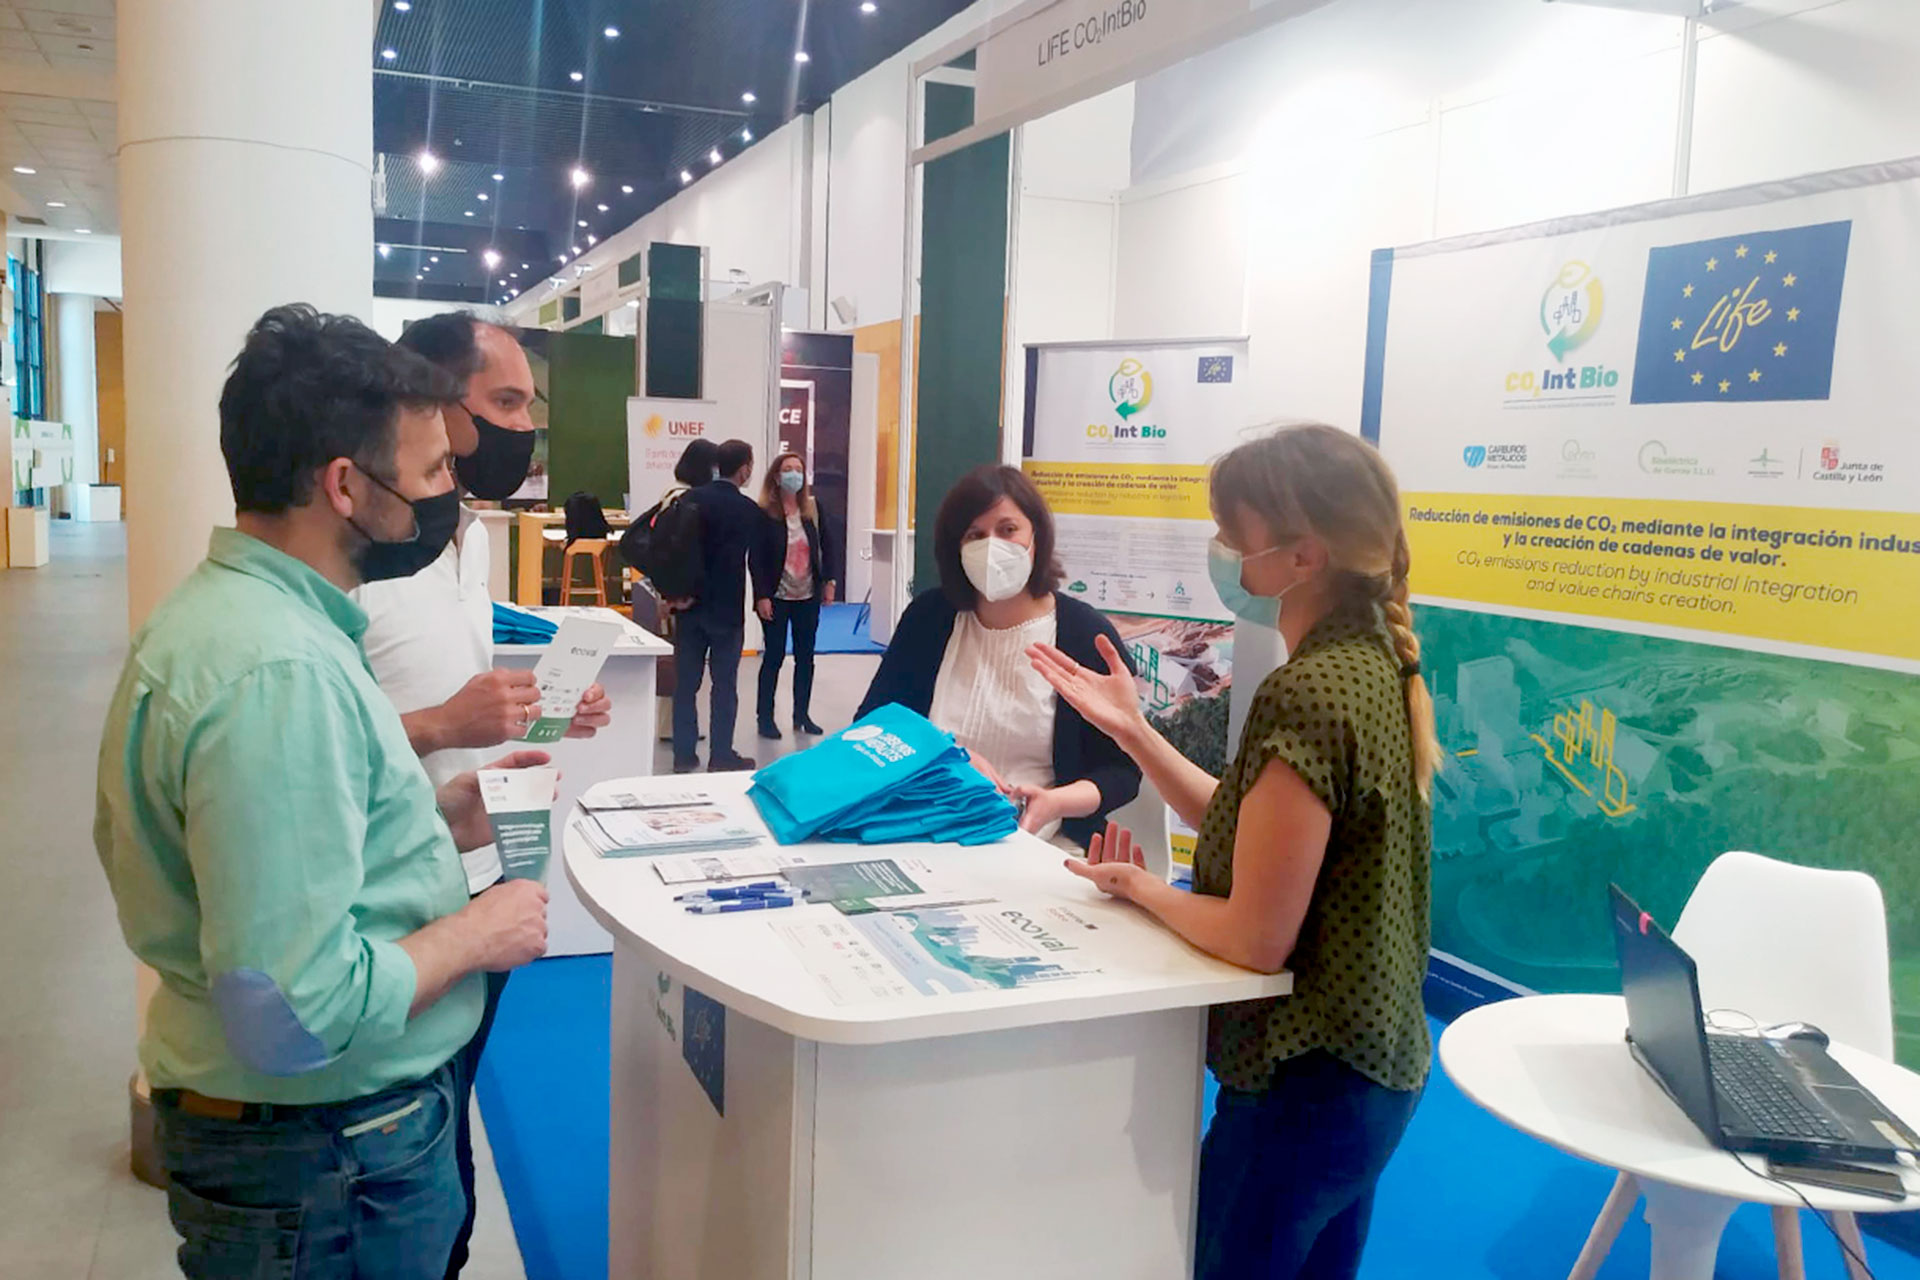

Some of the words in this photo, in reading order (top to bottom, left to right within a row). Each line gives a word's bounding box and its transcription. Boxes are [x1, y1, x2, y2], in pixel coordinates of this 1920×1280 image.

[1038, 28, 1070, 66] LIFE
[1691, 276, 1772, 352] Life
[1580, 365, 1619, 388] Bio
[668, 420, 705, 436] UNEF
[1141, 425, 1167, 438] Bio
[1813, 471, 1847, 481] Castilla
[1848, 475, 1855, 484] y
[1857, 473, 1884, 482] León
[1840, 462, 1868, 471] Junta
[1870, 462, 1884, 471] de
[1409, 507, 1470, 523] Reducción
[1473, 510, 1488, 524] de
[1492, 511, 1560, 529] emisiones
[1564, 514, 1583, 530] de
[1621, 519, 1704, 538] mediante
[1709, 522, 1726, 539] la
[1731, 524, 1853, 549] integración
[1503, 533, 1512, 548] y
[1515, 532, 1527, 546] la
[1531, 534, 1595, 550] creación
[1599, 537, 1618, 553] de
[1623, 541, 1695, 559] cadenas
[1700, 544, 1723, 561] de
[1729, 548, 1787, 567] valor.
[1484, 555, 1549, 573] emissions
[1552, 560, 1625, 580] reduction
[1629, 565, 1651, 587] by
[1654, 568, 1740, 592] industrial
[1743, 575, 1858, 604] integration
[1526, 578, 1556, 593] and
[1558, 580, 1600, 598] value
[1602, 584, 1655, 604] chains
[1659, 593, 1737, 614] creation.
[1001, 910, 1079, 952] ecoval
